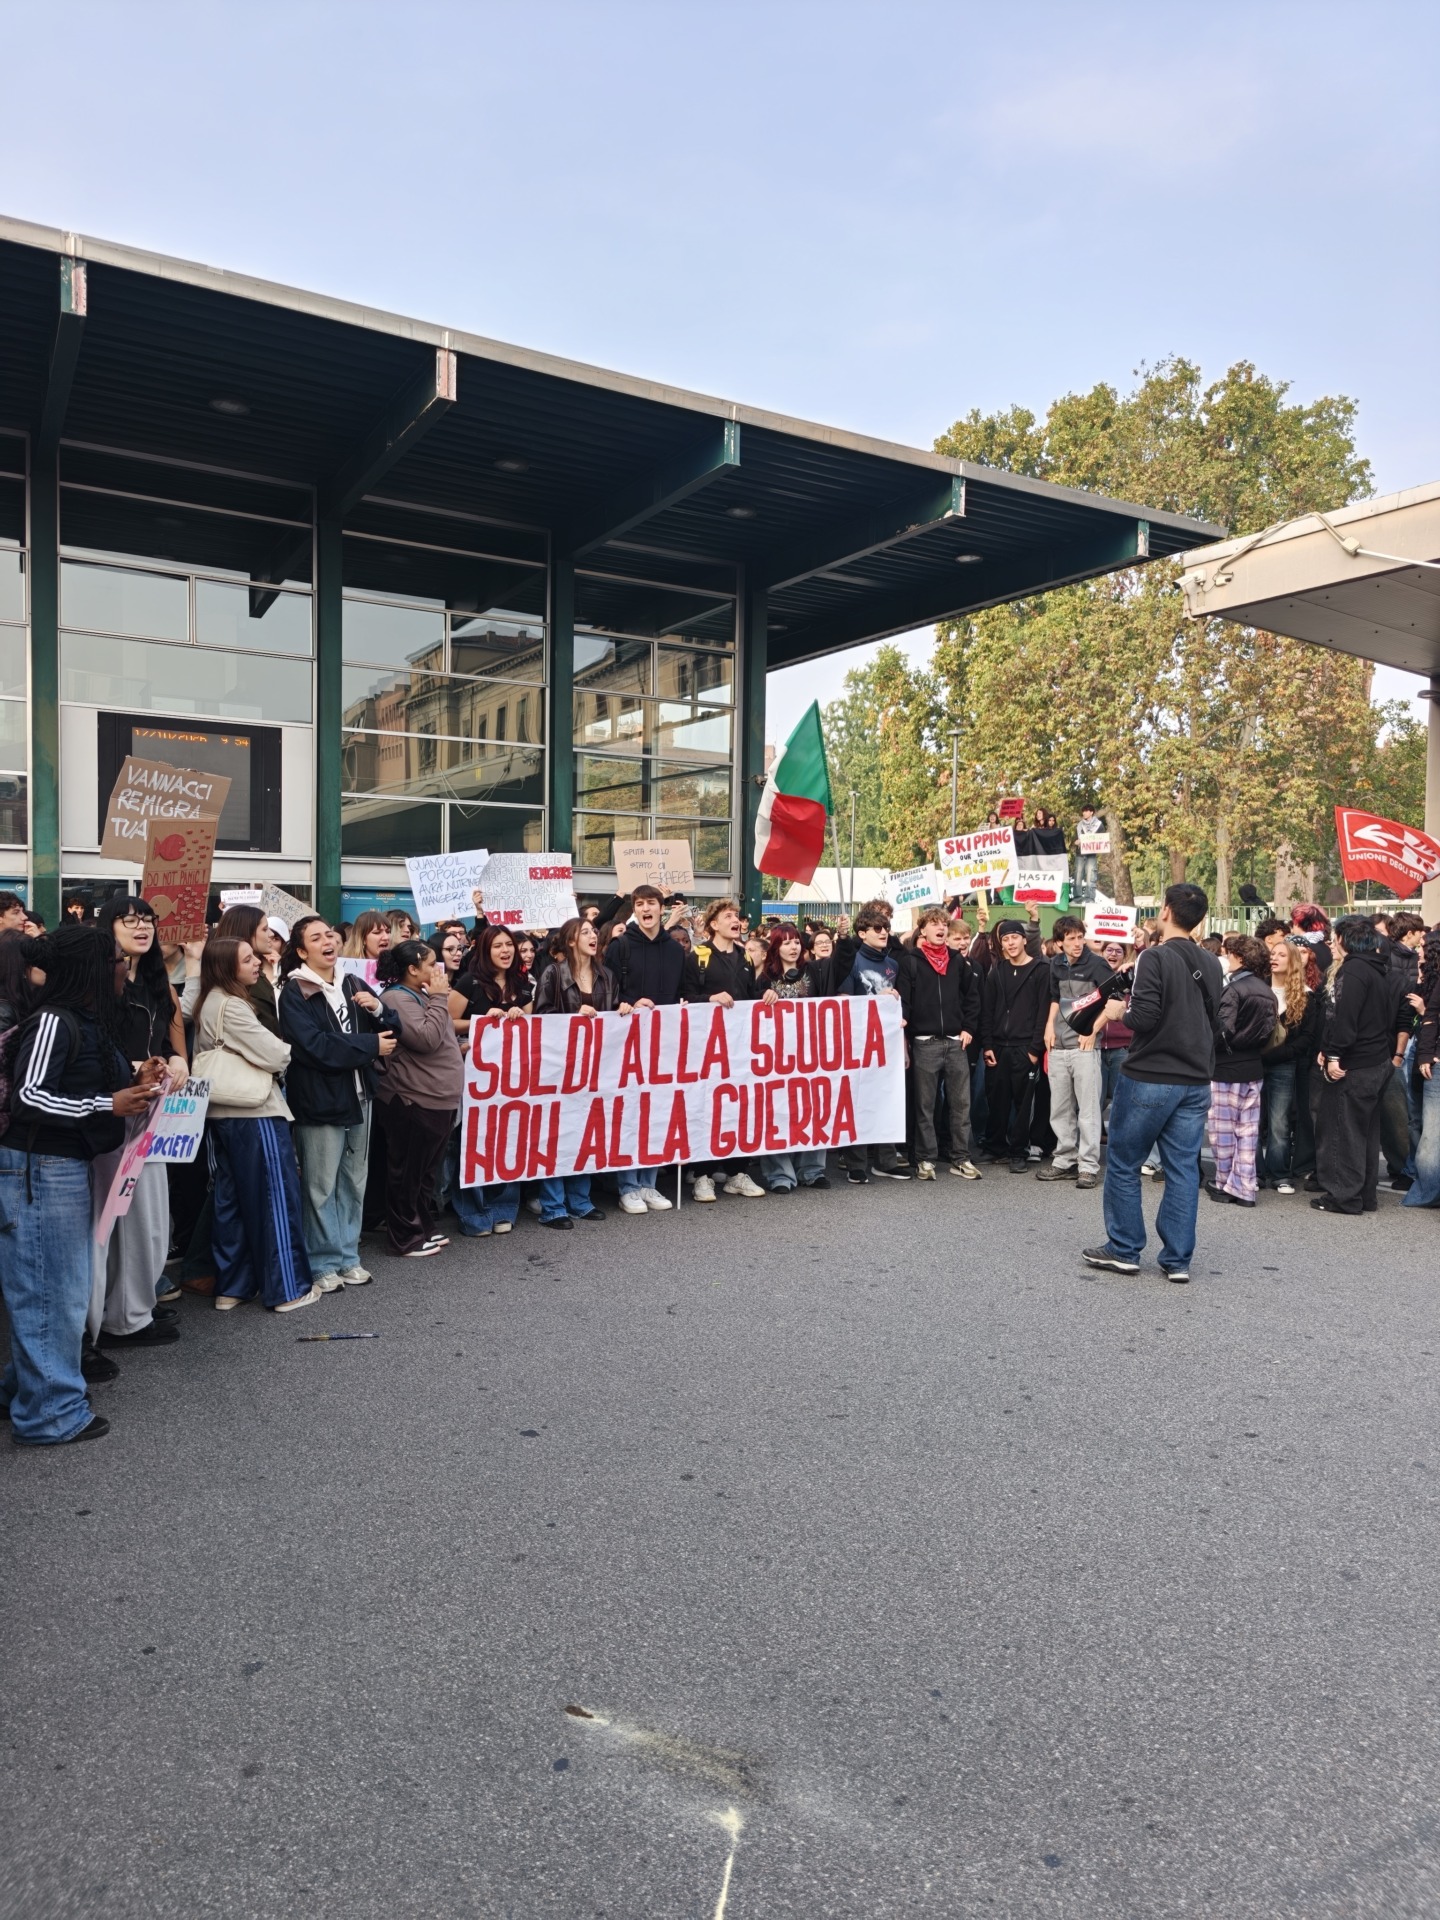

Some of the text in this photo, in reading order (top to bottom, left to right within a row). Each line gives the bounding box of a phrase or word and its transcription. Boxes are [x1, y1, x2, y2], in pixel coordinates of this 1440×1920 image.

[127, 765, 213, 801] VANNACCI
[117, 788, 200, 819] REMIGRA
[944, 828, 1012, 855] SKIPPING
[408, 855, 455, 872] QUANDO
[959, 852, 972, 861] OUR
[1347, 852, 1388, 863] UNIONE
[146, 872, 159, 887] DO
[163, 871, 178, 886] NOT
[419, 866, 468, 883] POPOLO
[529, 866, 573, 880] REMIGRARE
[943, 861, 988, 881] TEACH
[1018, 872, 1055, 882] HASTA
[969, 875, 992, 889] ONE
[895, 886, 931, 905] GUERRA
[1102, 906, 1122, 915] SOLDI
[157, 925, 201, 941] GANIZE
[468, 999, 886, 1100] SOLDI ALLA SCUOLA
[465, 1075, 857, 1185] NON ALLA GUERRA
